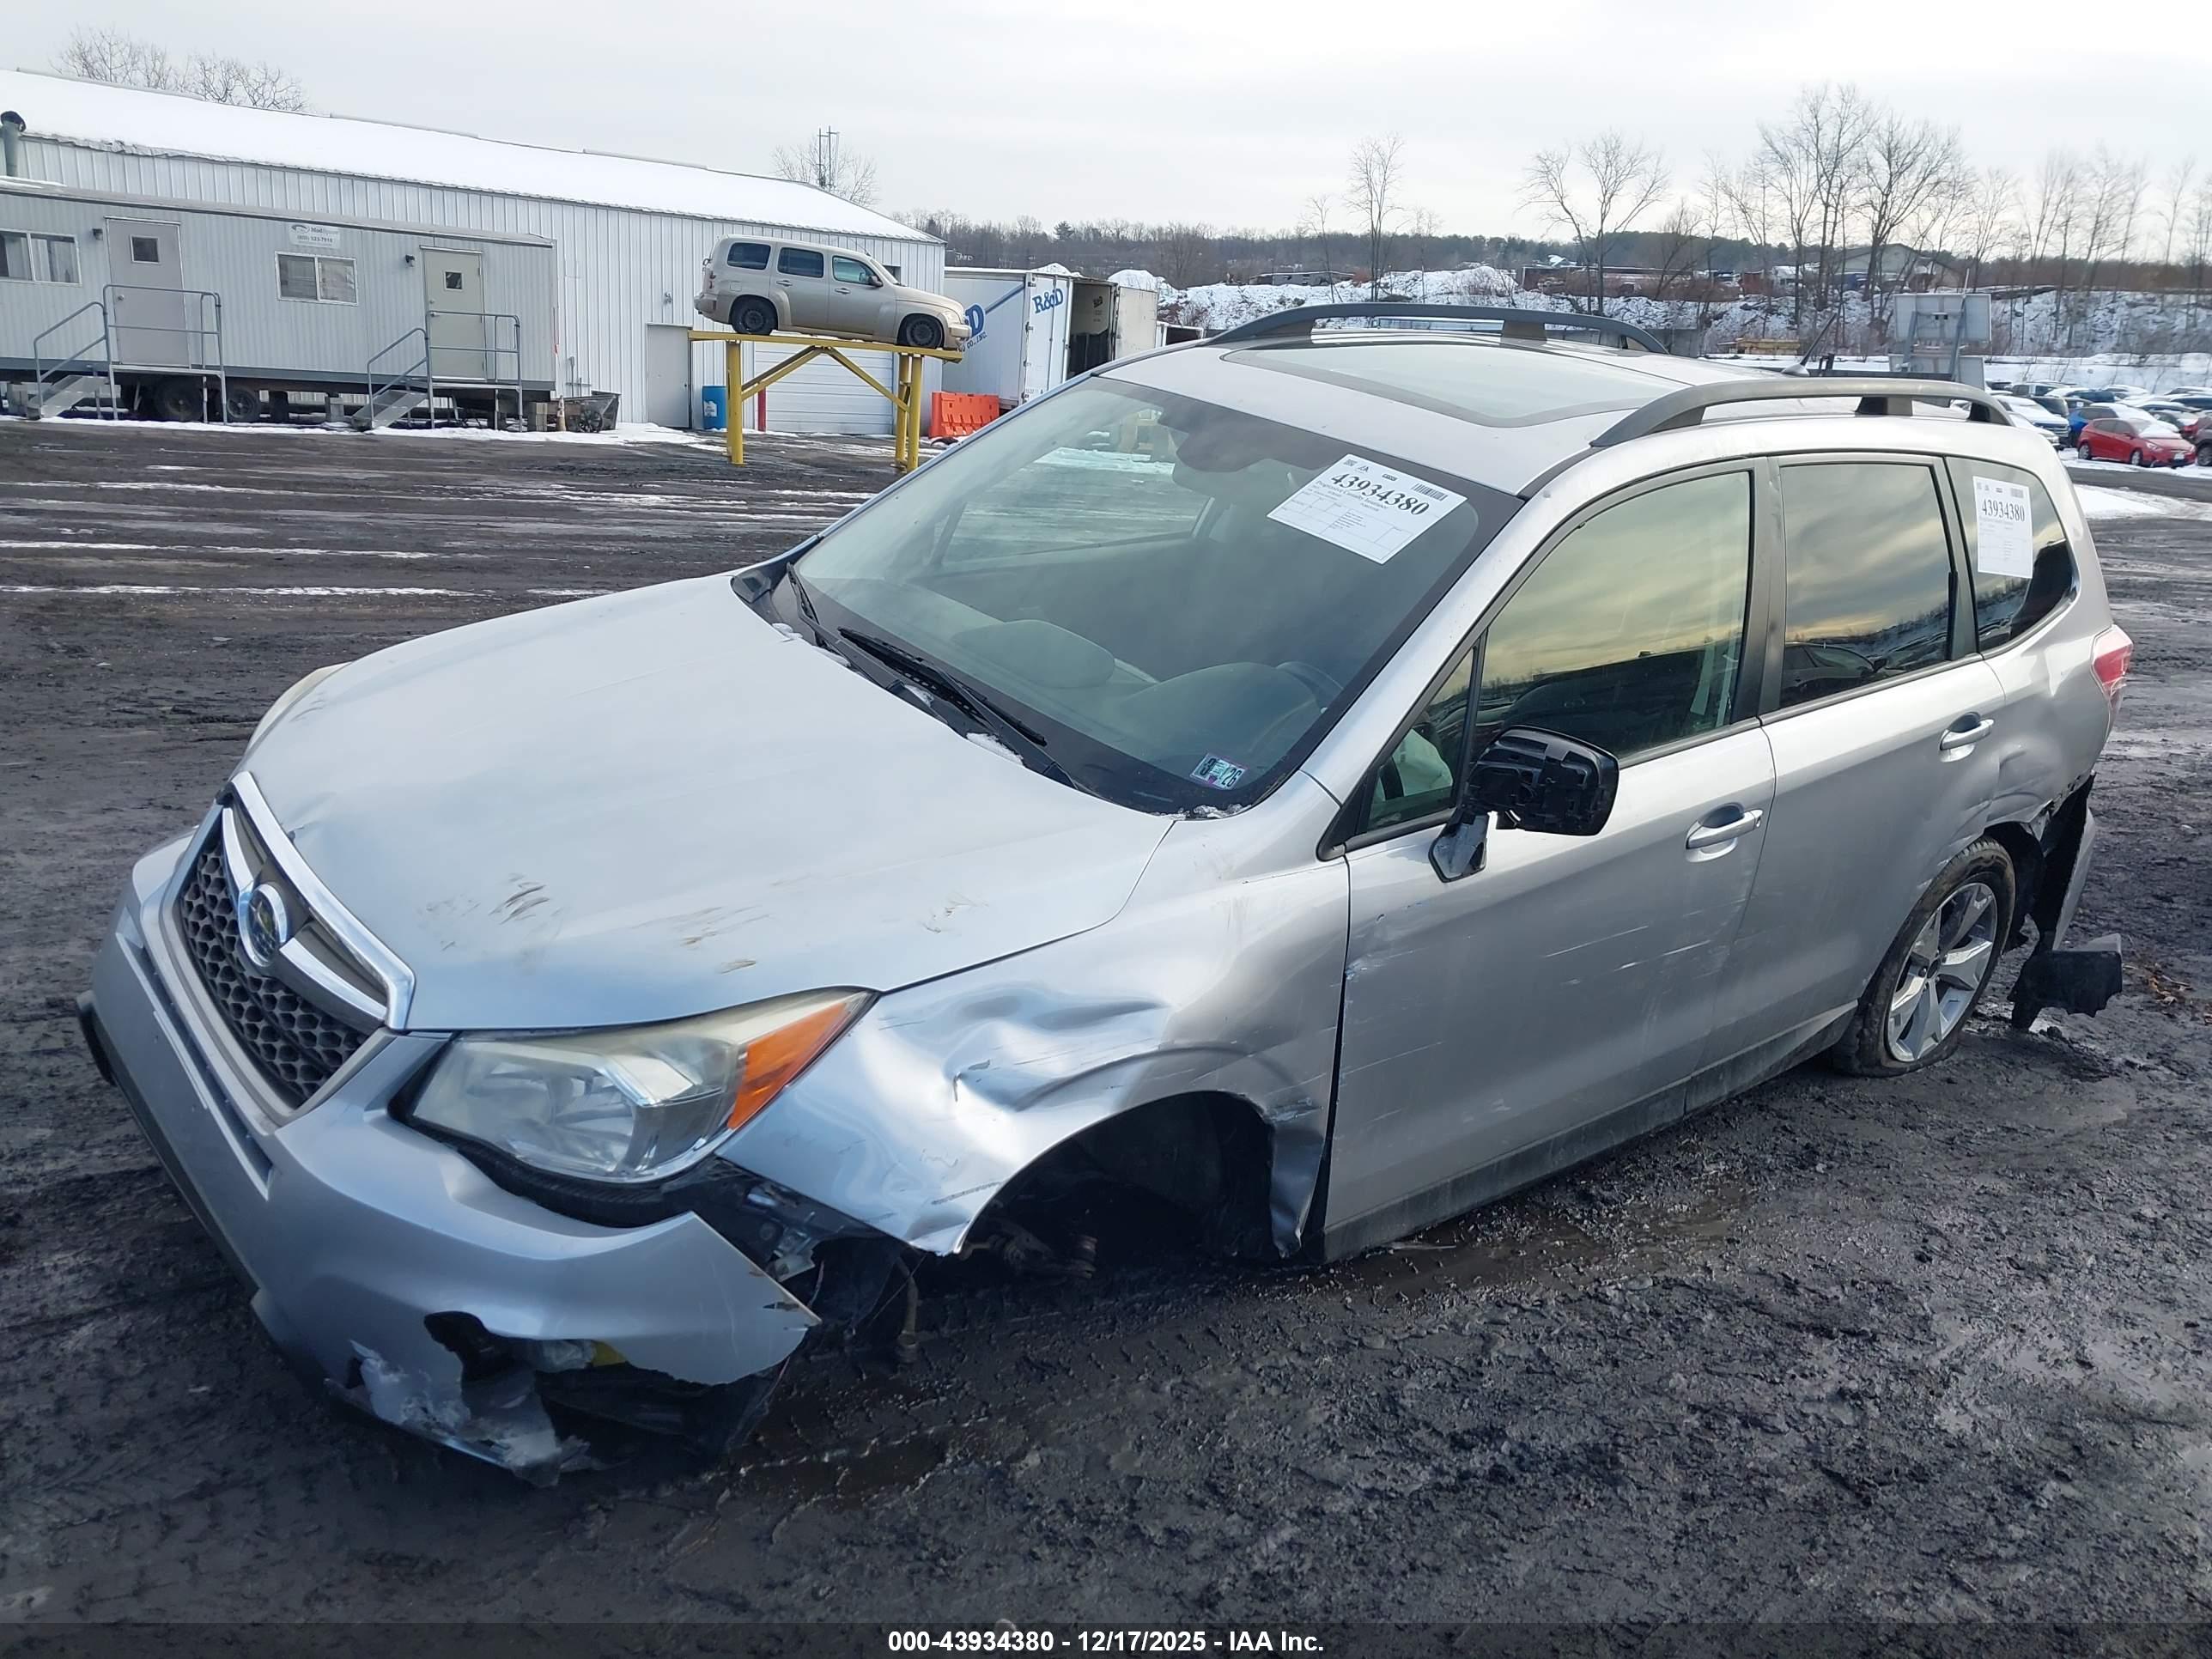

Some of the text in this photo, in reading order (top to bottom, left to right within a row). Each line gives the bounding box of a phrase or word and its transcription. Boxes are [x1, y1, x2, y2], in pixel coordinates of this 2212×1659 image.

[1032, 288, 1064, 314] R&D
[1331, 473, 1430, 515] 43934380
[1982, 498, 2025, 522] 43934380
